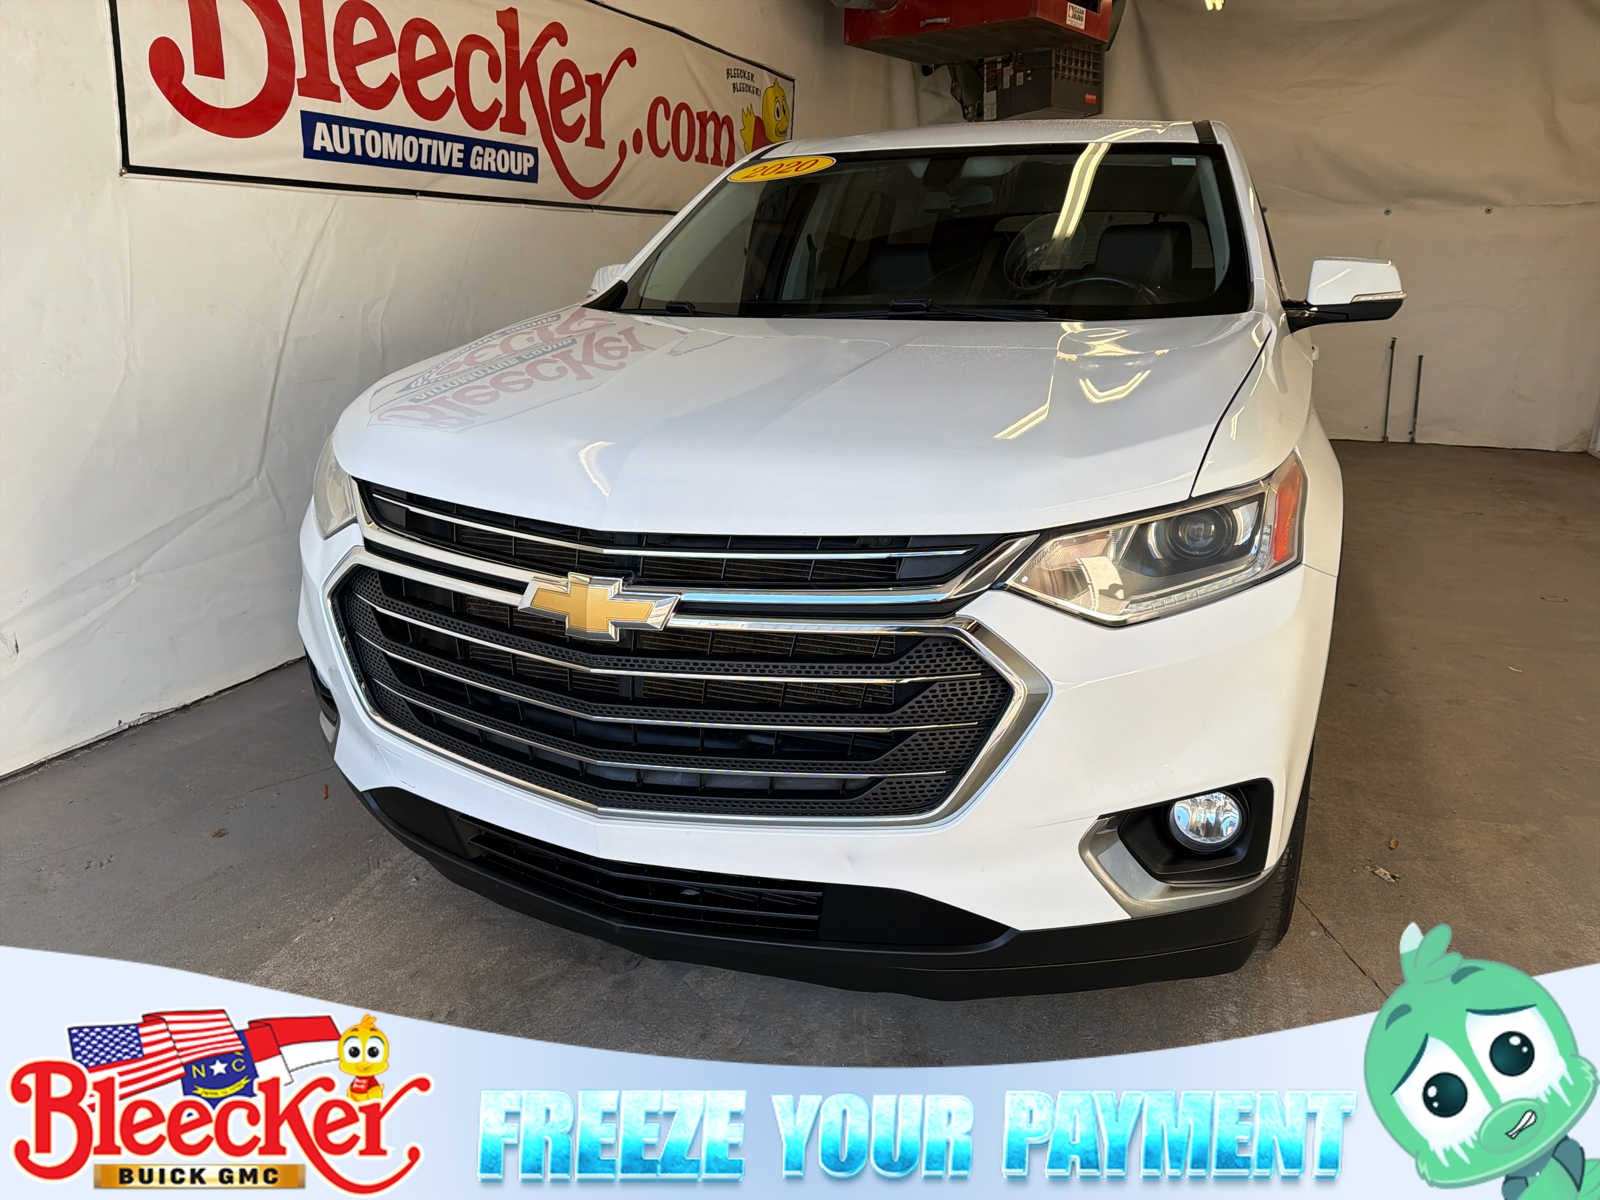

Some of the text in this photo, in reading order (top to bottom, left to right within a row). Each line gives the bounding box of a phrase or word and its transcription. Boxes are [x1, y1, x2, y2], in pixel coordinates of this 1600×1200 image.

[313, 121, 536, 176] AUTOMOTIVE GROUP
[741, 159, 820, 180] 2020
